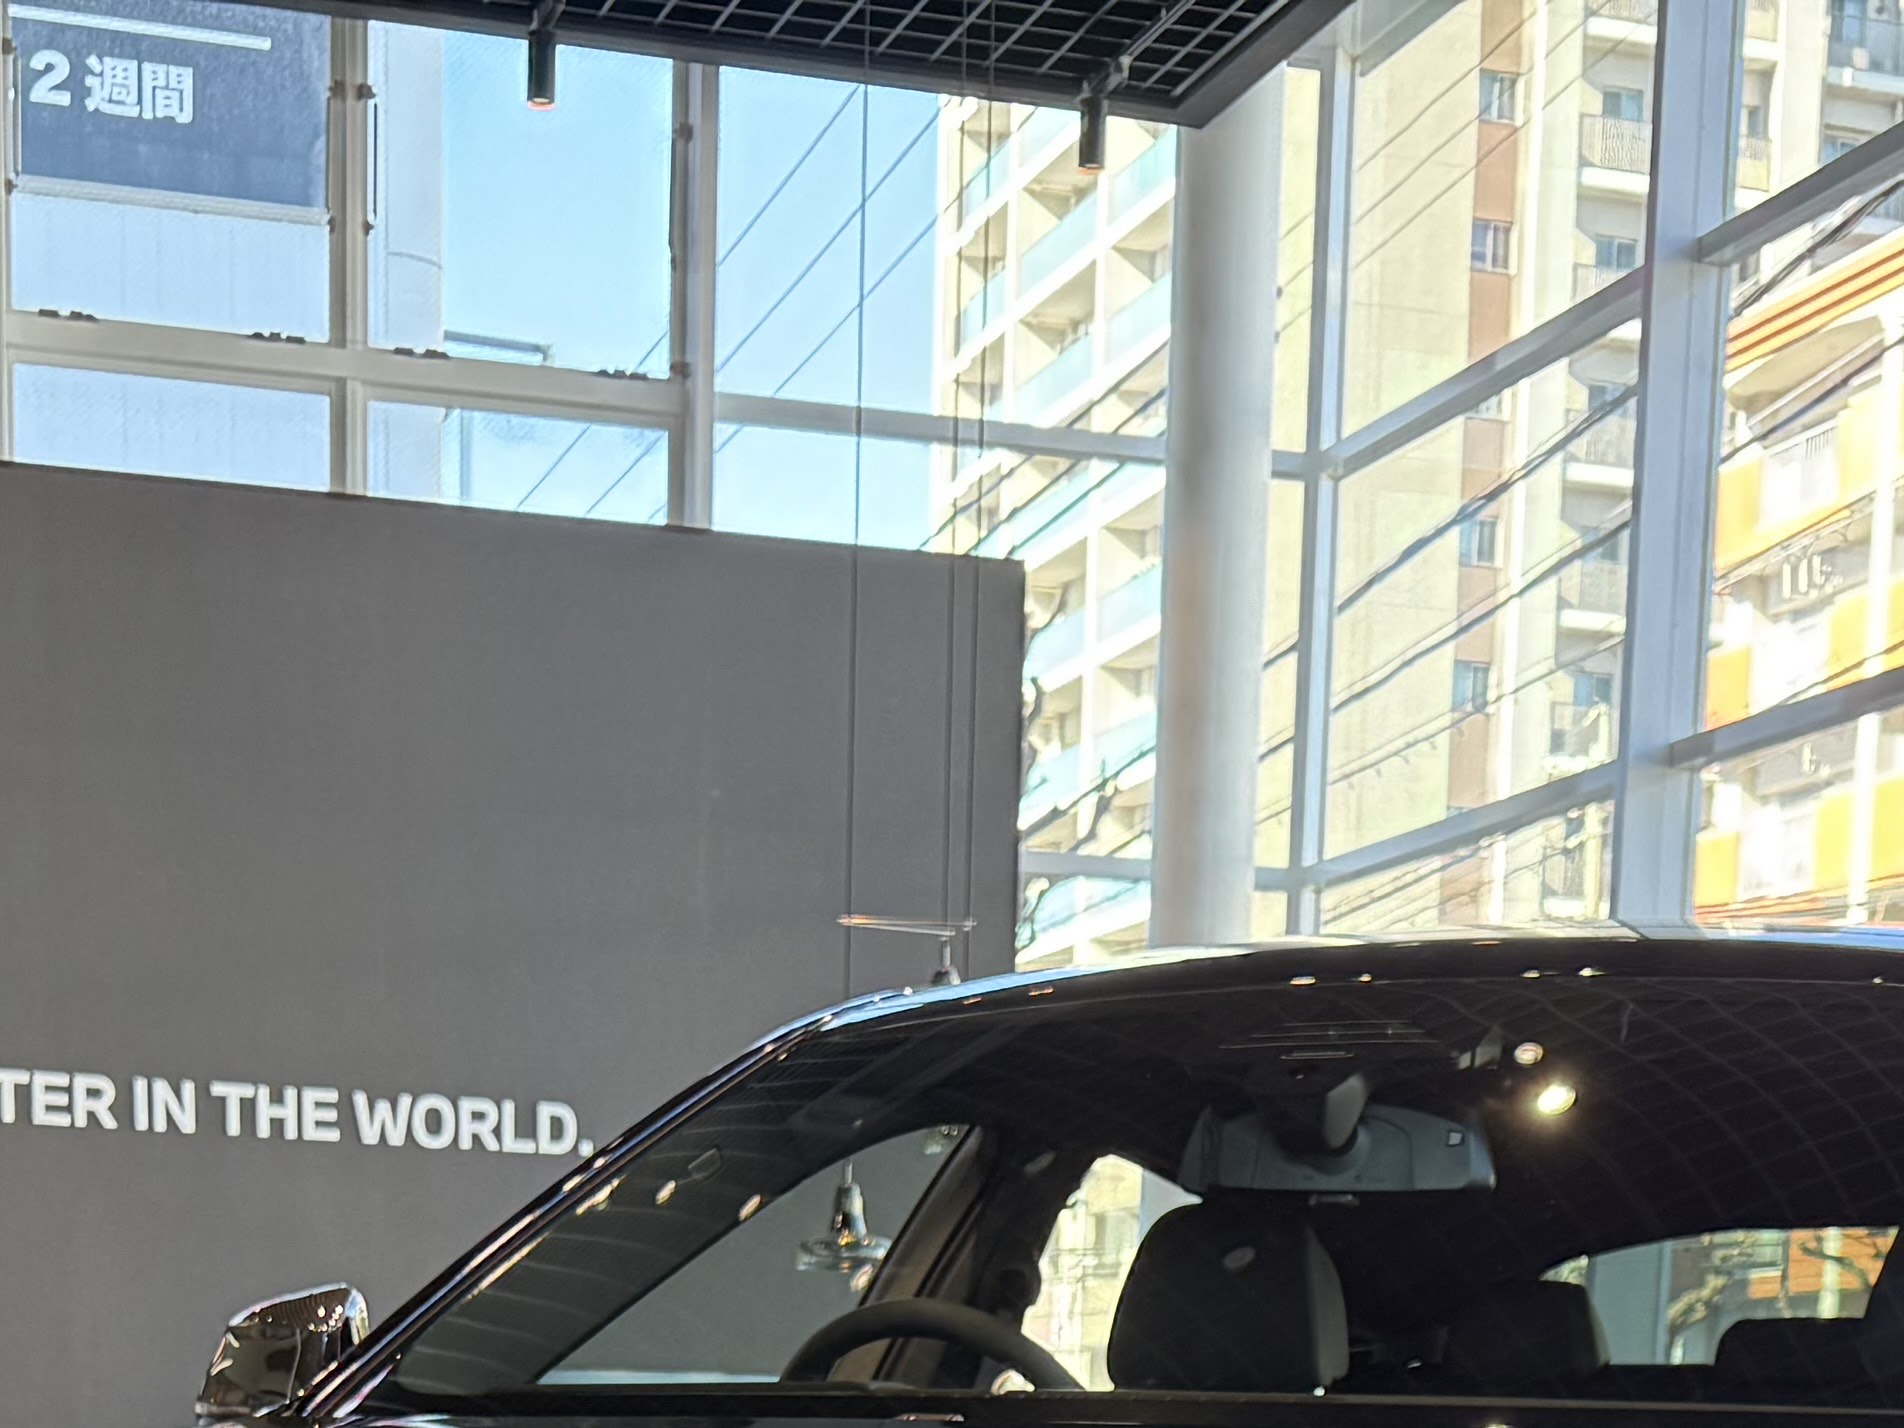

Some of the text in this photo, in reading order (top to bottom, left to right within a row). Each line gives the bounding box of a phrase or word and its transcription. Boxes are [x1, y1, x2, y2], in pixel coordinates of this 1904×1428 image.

[132, 1075, 196, 1135] IN
[209, 1080, 341, 1143] THE
[352, 1090, 595, 1157] WORLD.
